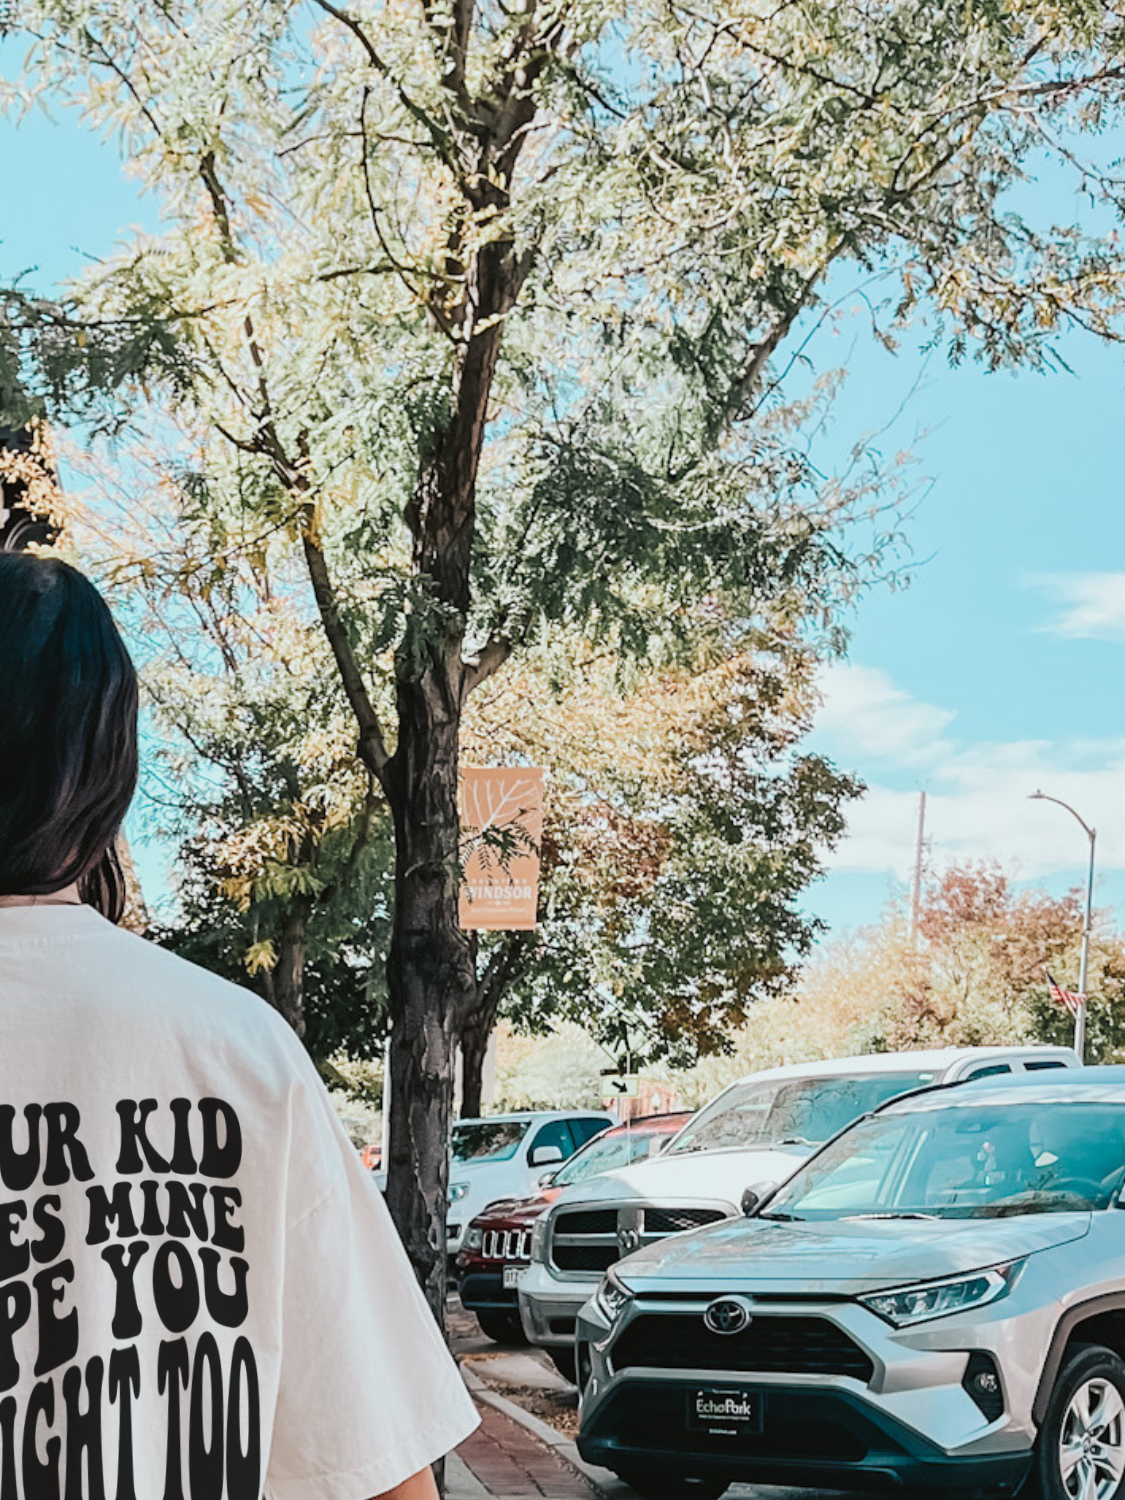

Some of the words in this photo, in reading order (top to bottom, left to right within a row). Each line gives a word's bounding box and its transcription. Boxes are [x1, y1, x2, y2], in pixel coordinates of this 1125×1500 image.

[114, 1096, 243, 1179] KID
[84, 1179, 246, 1254] MINE
[100, 1239, 250, 1341] YOU
[696, 1398, 751, 1415] EchoPark
